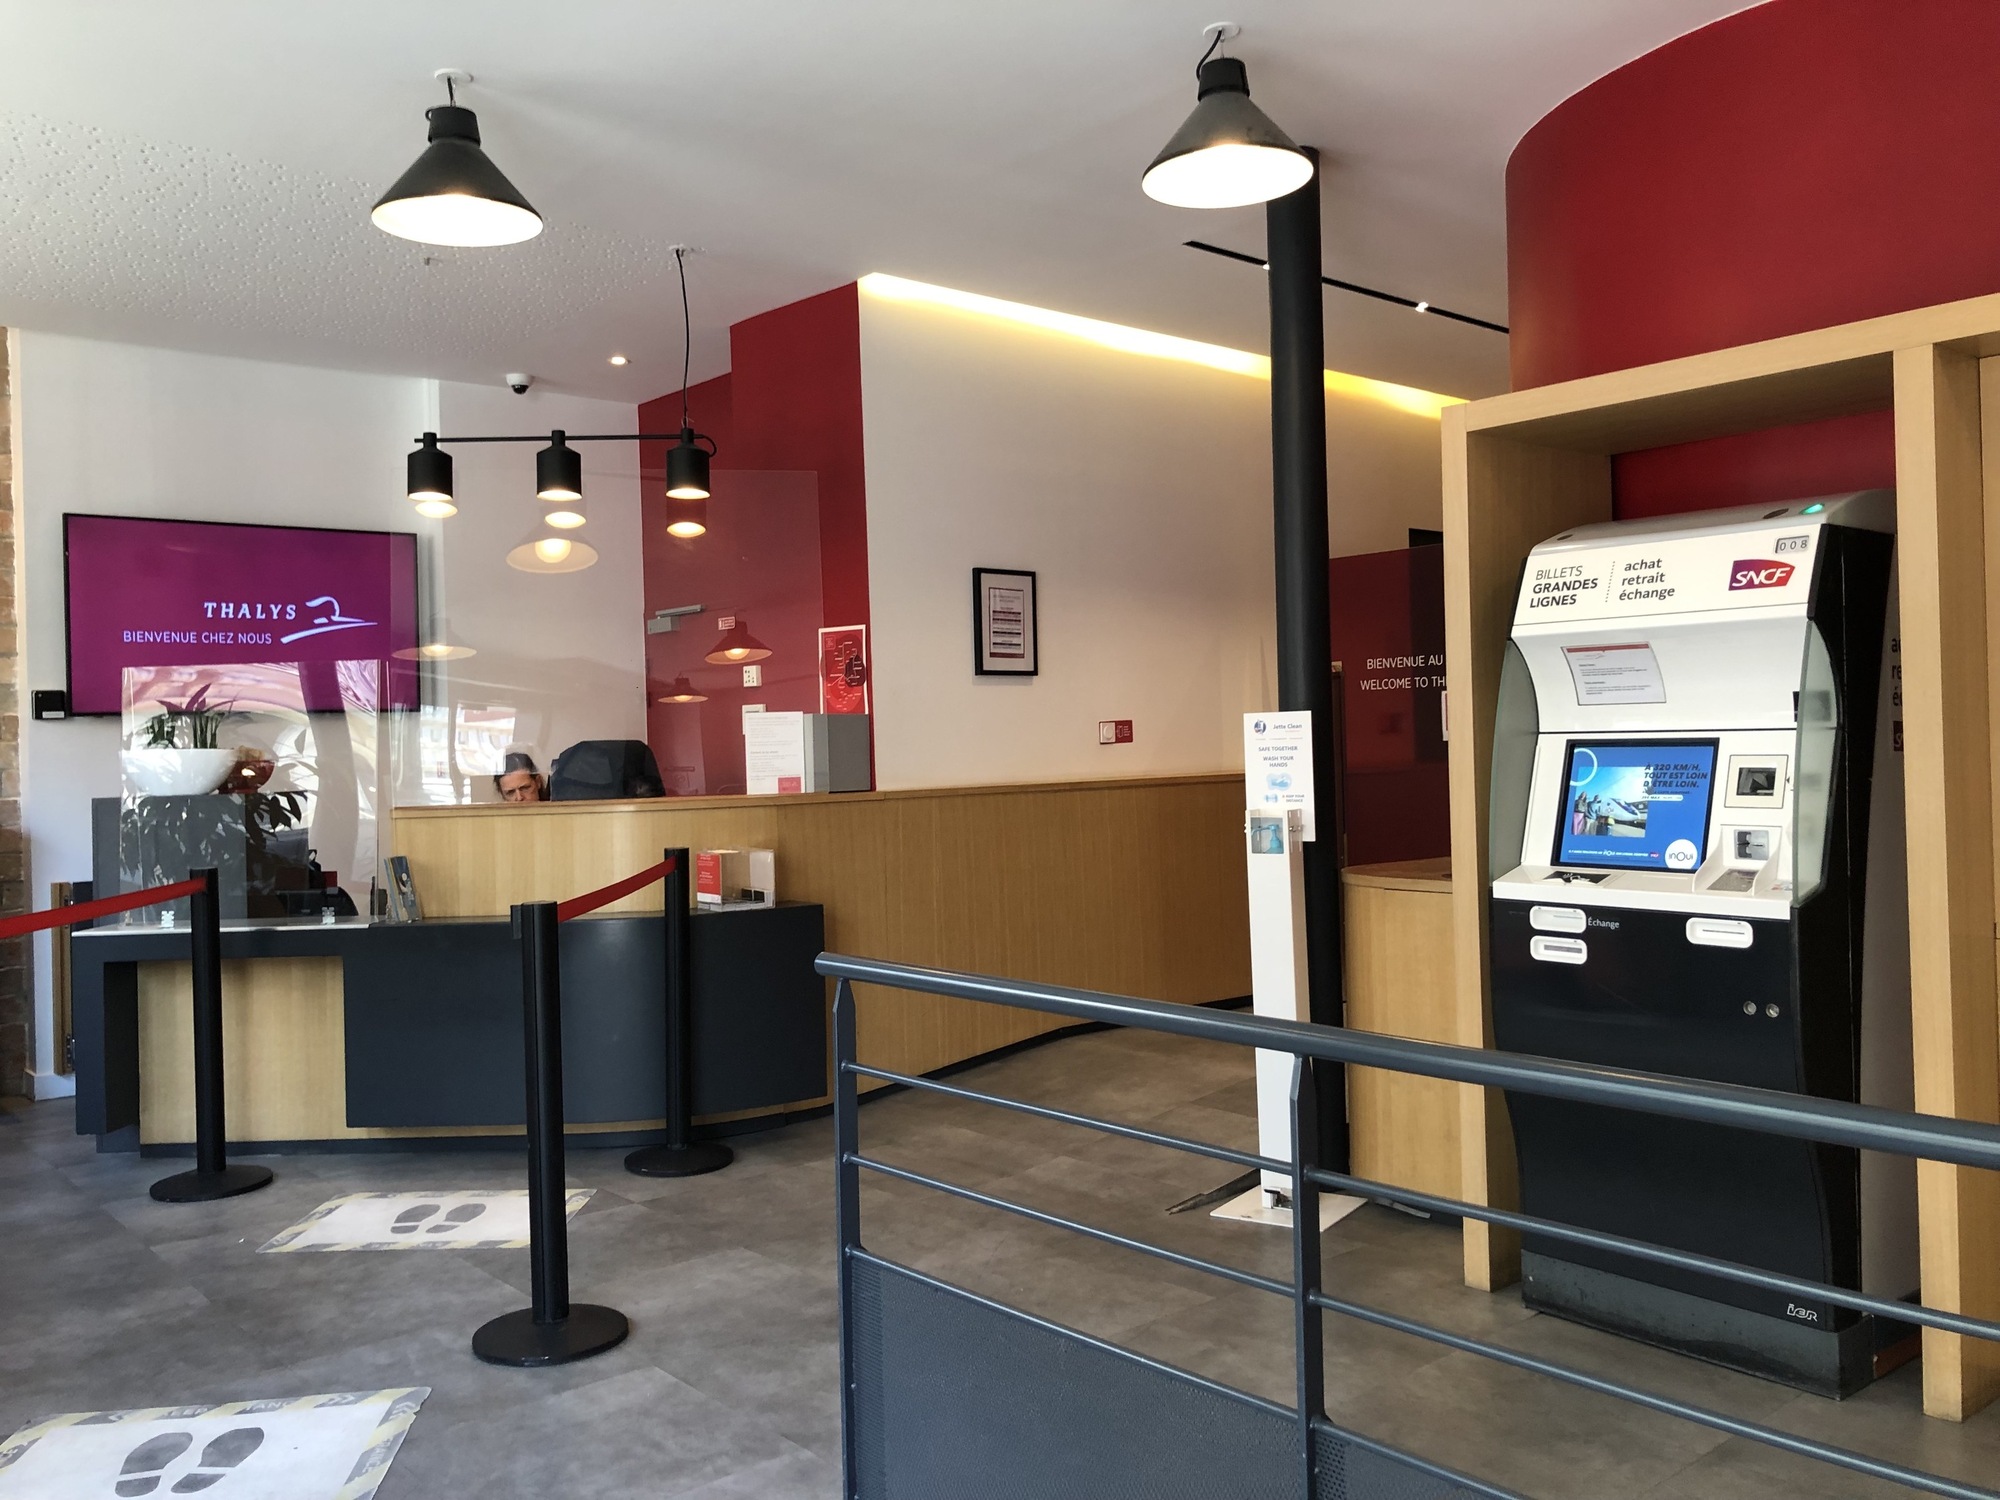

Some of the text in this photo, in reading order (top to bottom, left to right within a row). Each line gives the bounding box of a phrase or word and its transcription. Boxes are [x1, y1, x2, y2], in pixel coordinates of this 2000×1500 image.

[1624, 558, 1662, 572] achat
[1535, 565, 1583, 580] BILLETS
[1621, 572, 1665, 586] retrait
[1731, 567, 1791, 587] SNCF
[1532, 578, 1599, 594] GRANDES
[1529, 594, 1577, 608] LIGNES
[1618, 587, 1675, 601] échange
[203, 602, 296, 620] THALYS
[123, 630, 272, 645] BIENVENUE CHEZ NOUS
[1366, 654, 1444, 670] BIENVENUE AU
[1360, 677, 1412, 691] WELCOME
[1414, 676, 1429, 688] TO
[1653, 763, 1671, 771] 320
[1686, 772, 1708, 780] LOIN
[1675, 780, 1699, 788] LOIN.
[1588, 916, 1620, 930] Échange
